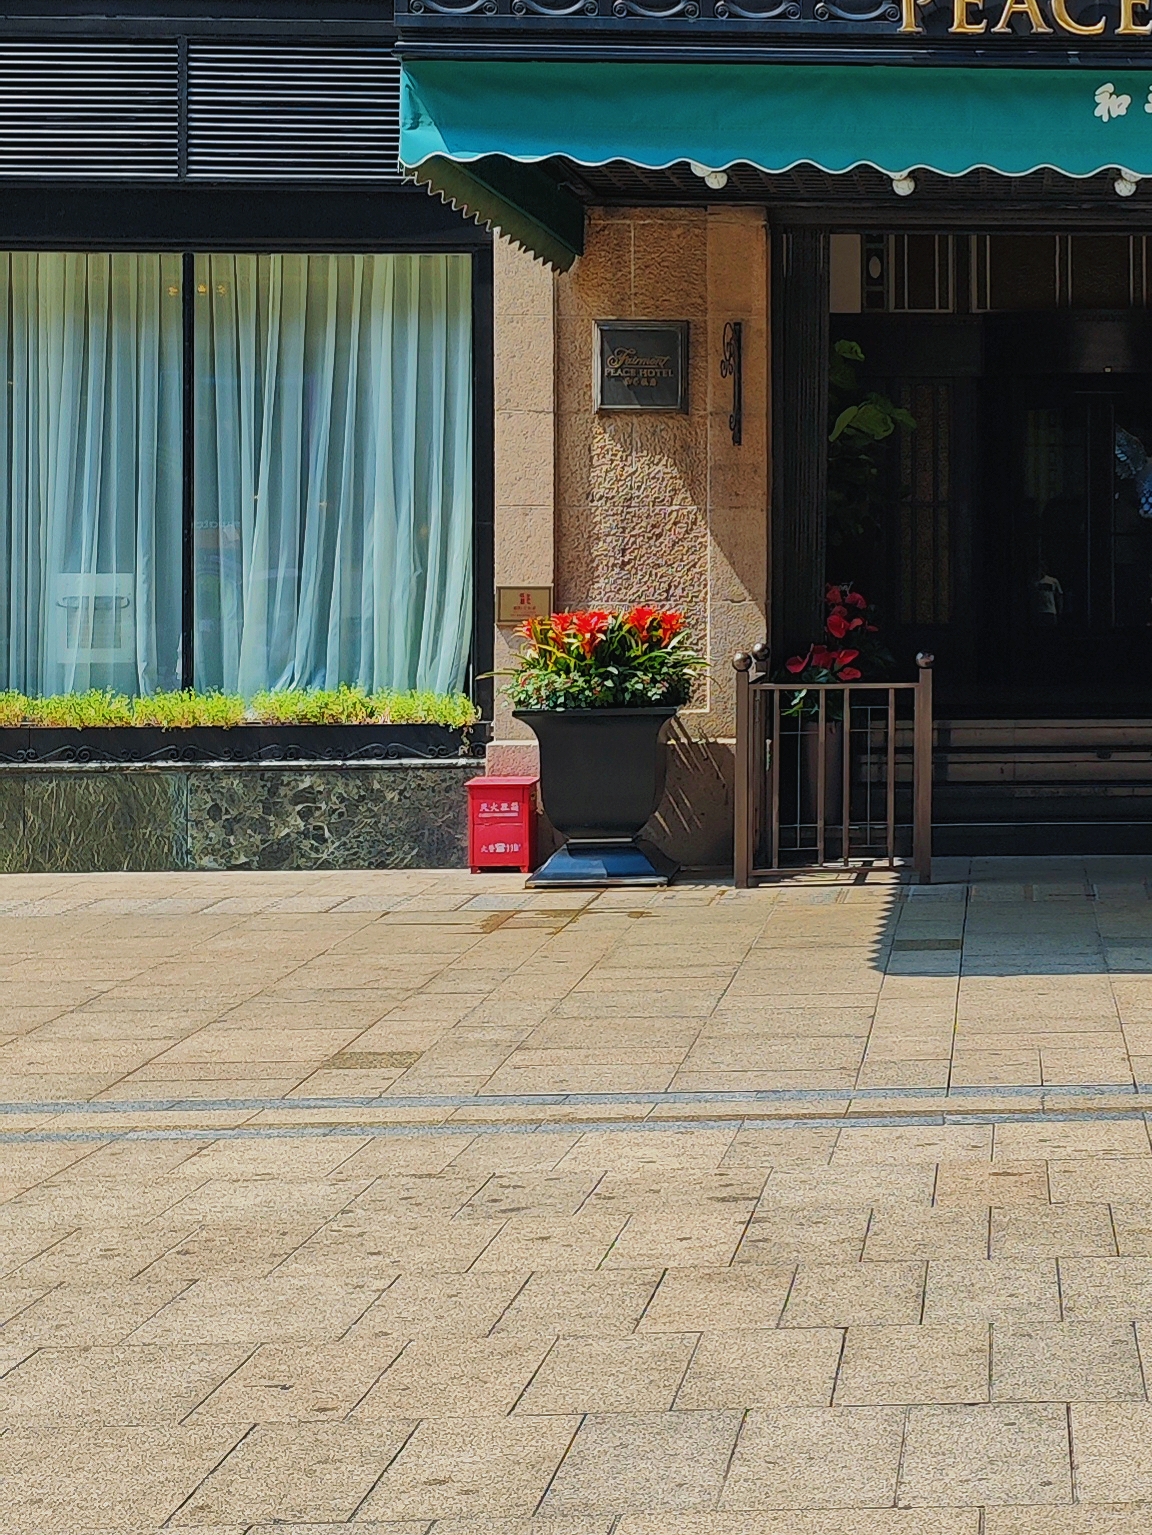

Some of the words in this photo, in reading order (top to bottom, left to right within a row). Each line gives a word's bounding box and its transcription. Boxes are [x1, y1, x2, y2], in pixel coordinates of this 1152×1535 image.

[606, 348, 673, 368] Fairmont
[605, 368, 637, 377] PEACE
[640, 368, 674, 378] HOTEL
